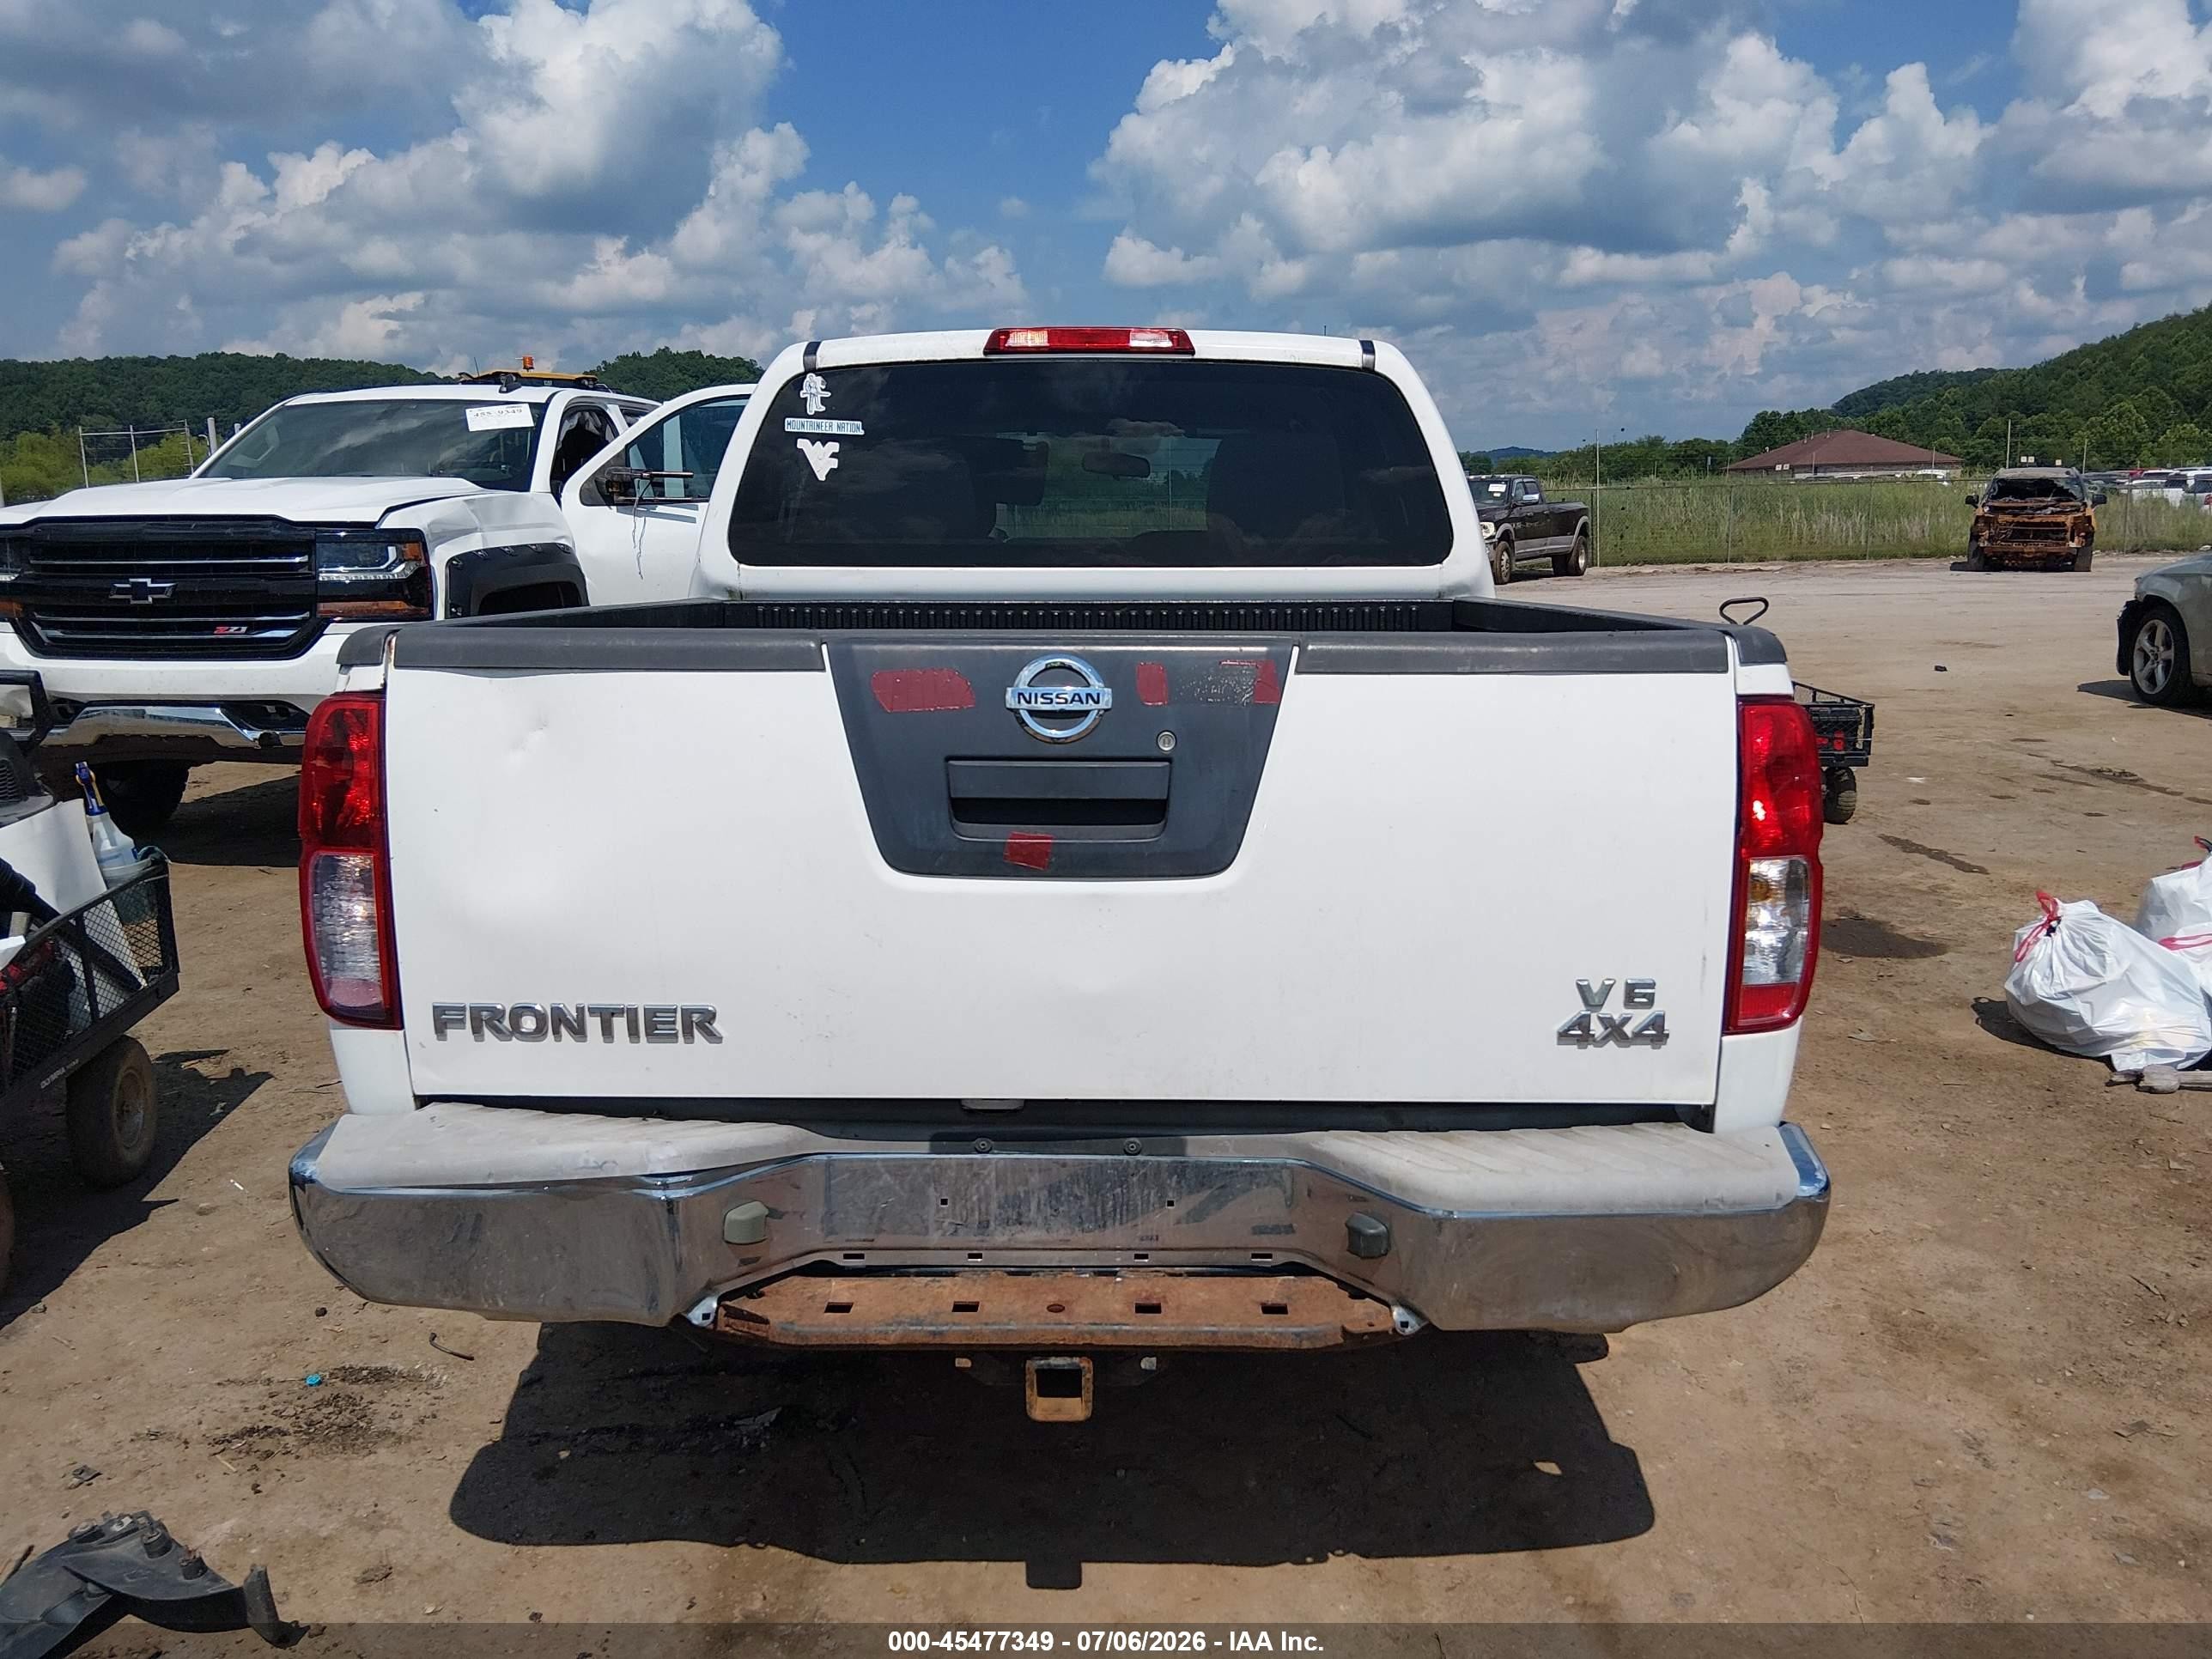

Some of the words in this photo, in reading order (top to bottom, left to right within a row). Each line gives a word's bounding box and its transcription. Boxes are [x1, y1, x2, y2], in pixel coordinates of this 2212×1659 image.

[787, 419, 833, 432] MOUNTAINEER
[1017, 691, 1101, 705] NISSAN
[432, 1002, 723, 1044] FRONTIER
